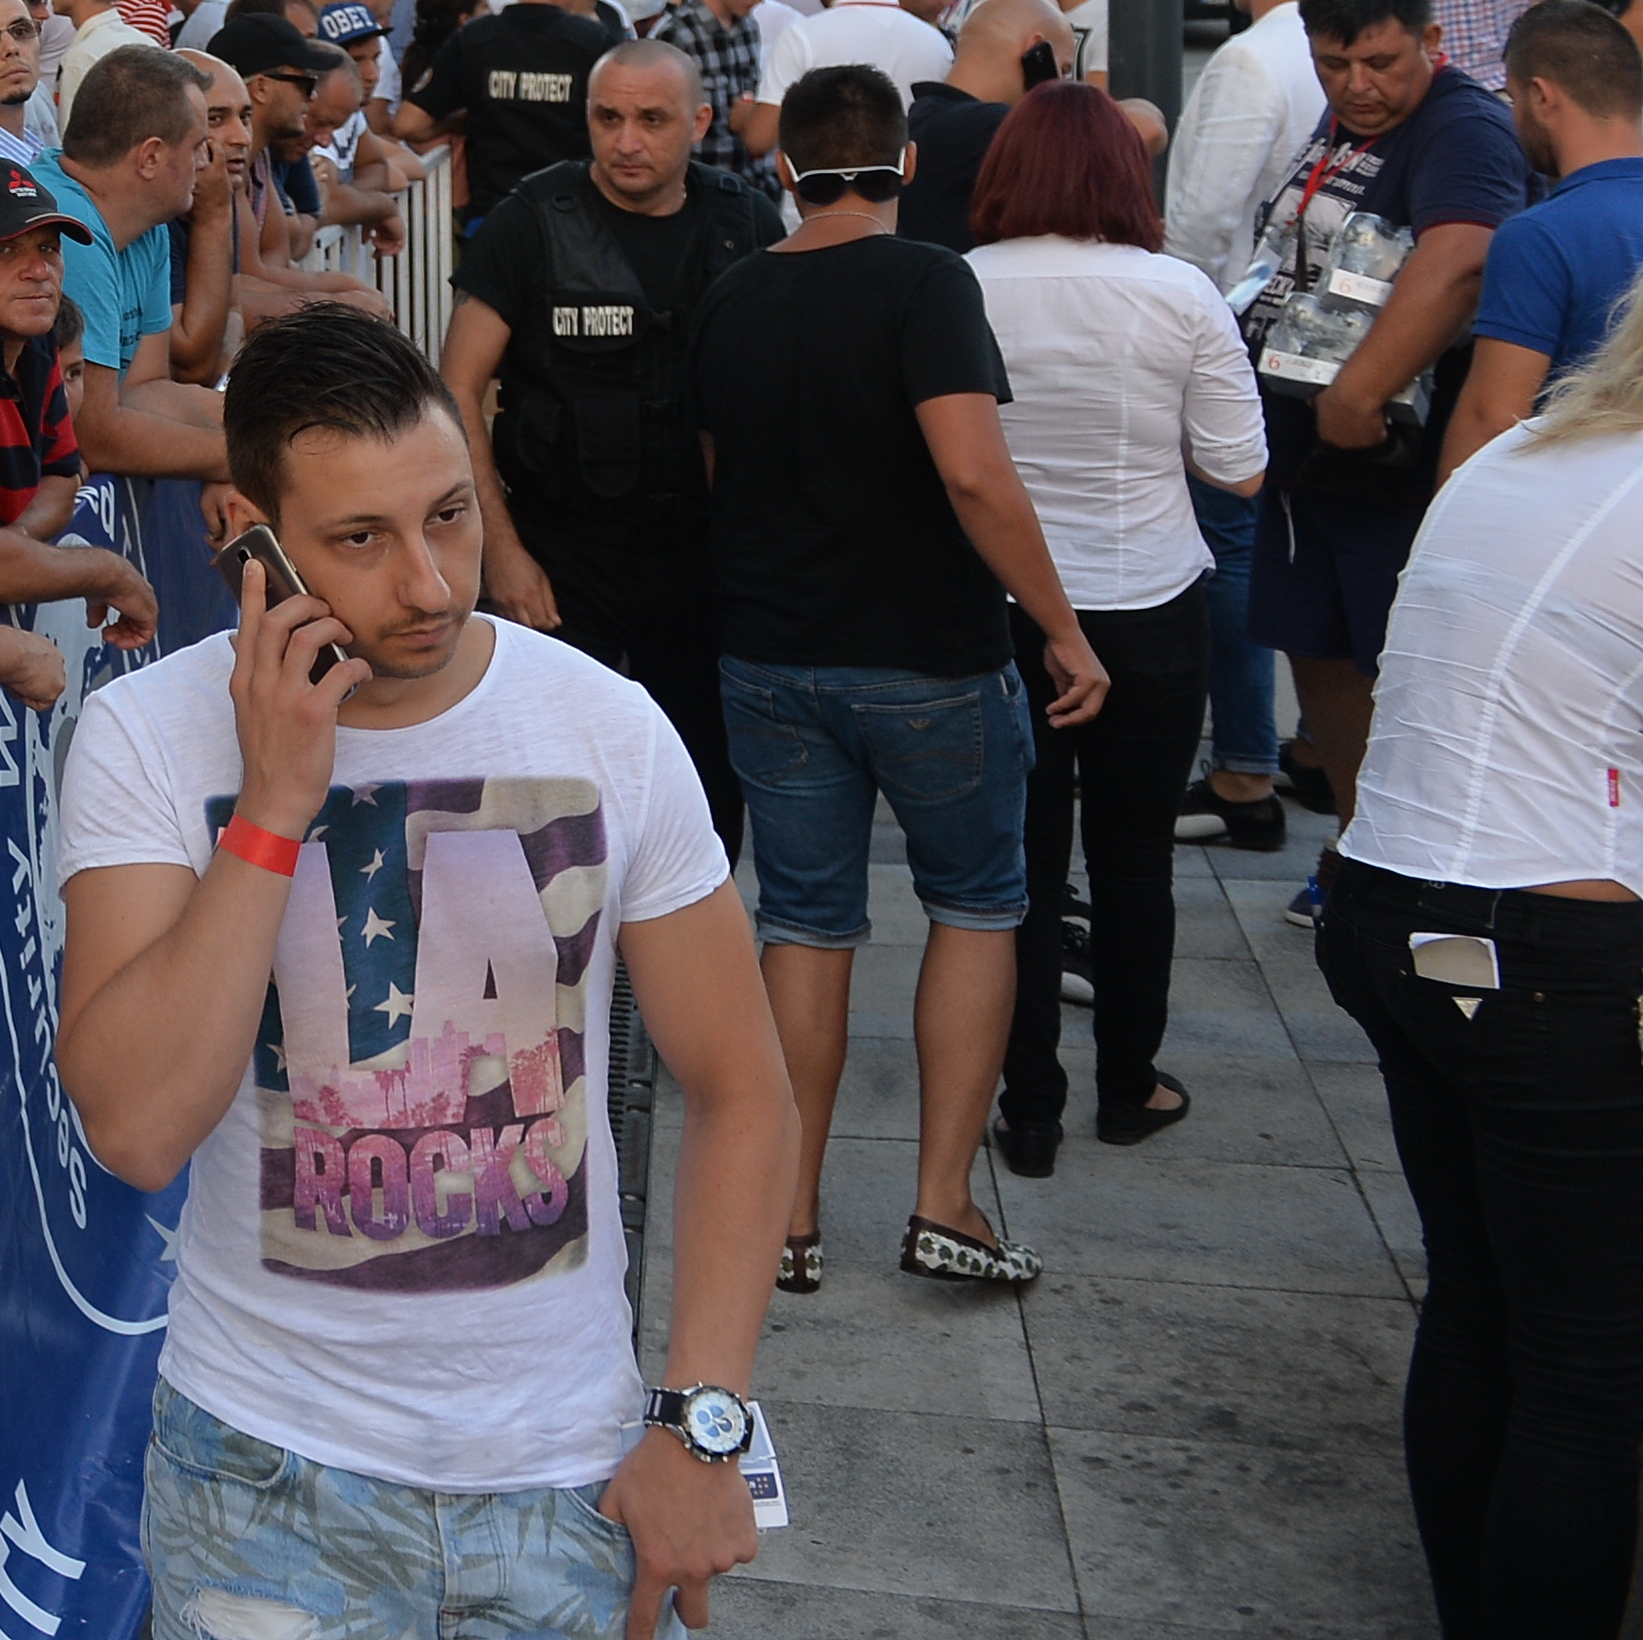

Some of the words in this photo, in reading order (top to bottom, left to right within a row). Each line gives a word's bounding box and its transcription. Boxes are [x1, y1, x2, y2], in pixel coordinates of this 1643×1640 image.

[321, 5, 374, 39] OBEY
[488, 69, 517, 100] CITY
[518, 71, 573, 103] PROTECT
[552, 306, 579, 336] CITY
[581, 305, 635, 336] PROTECT
[292, 1113, 569, 1239] ROCKS
